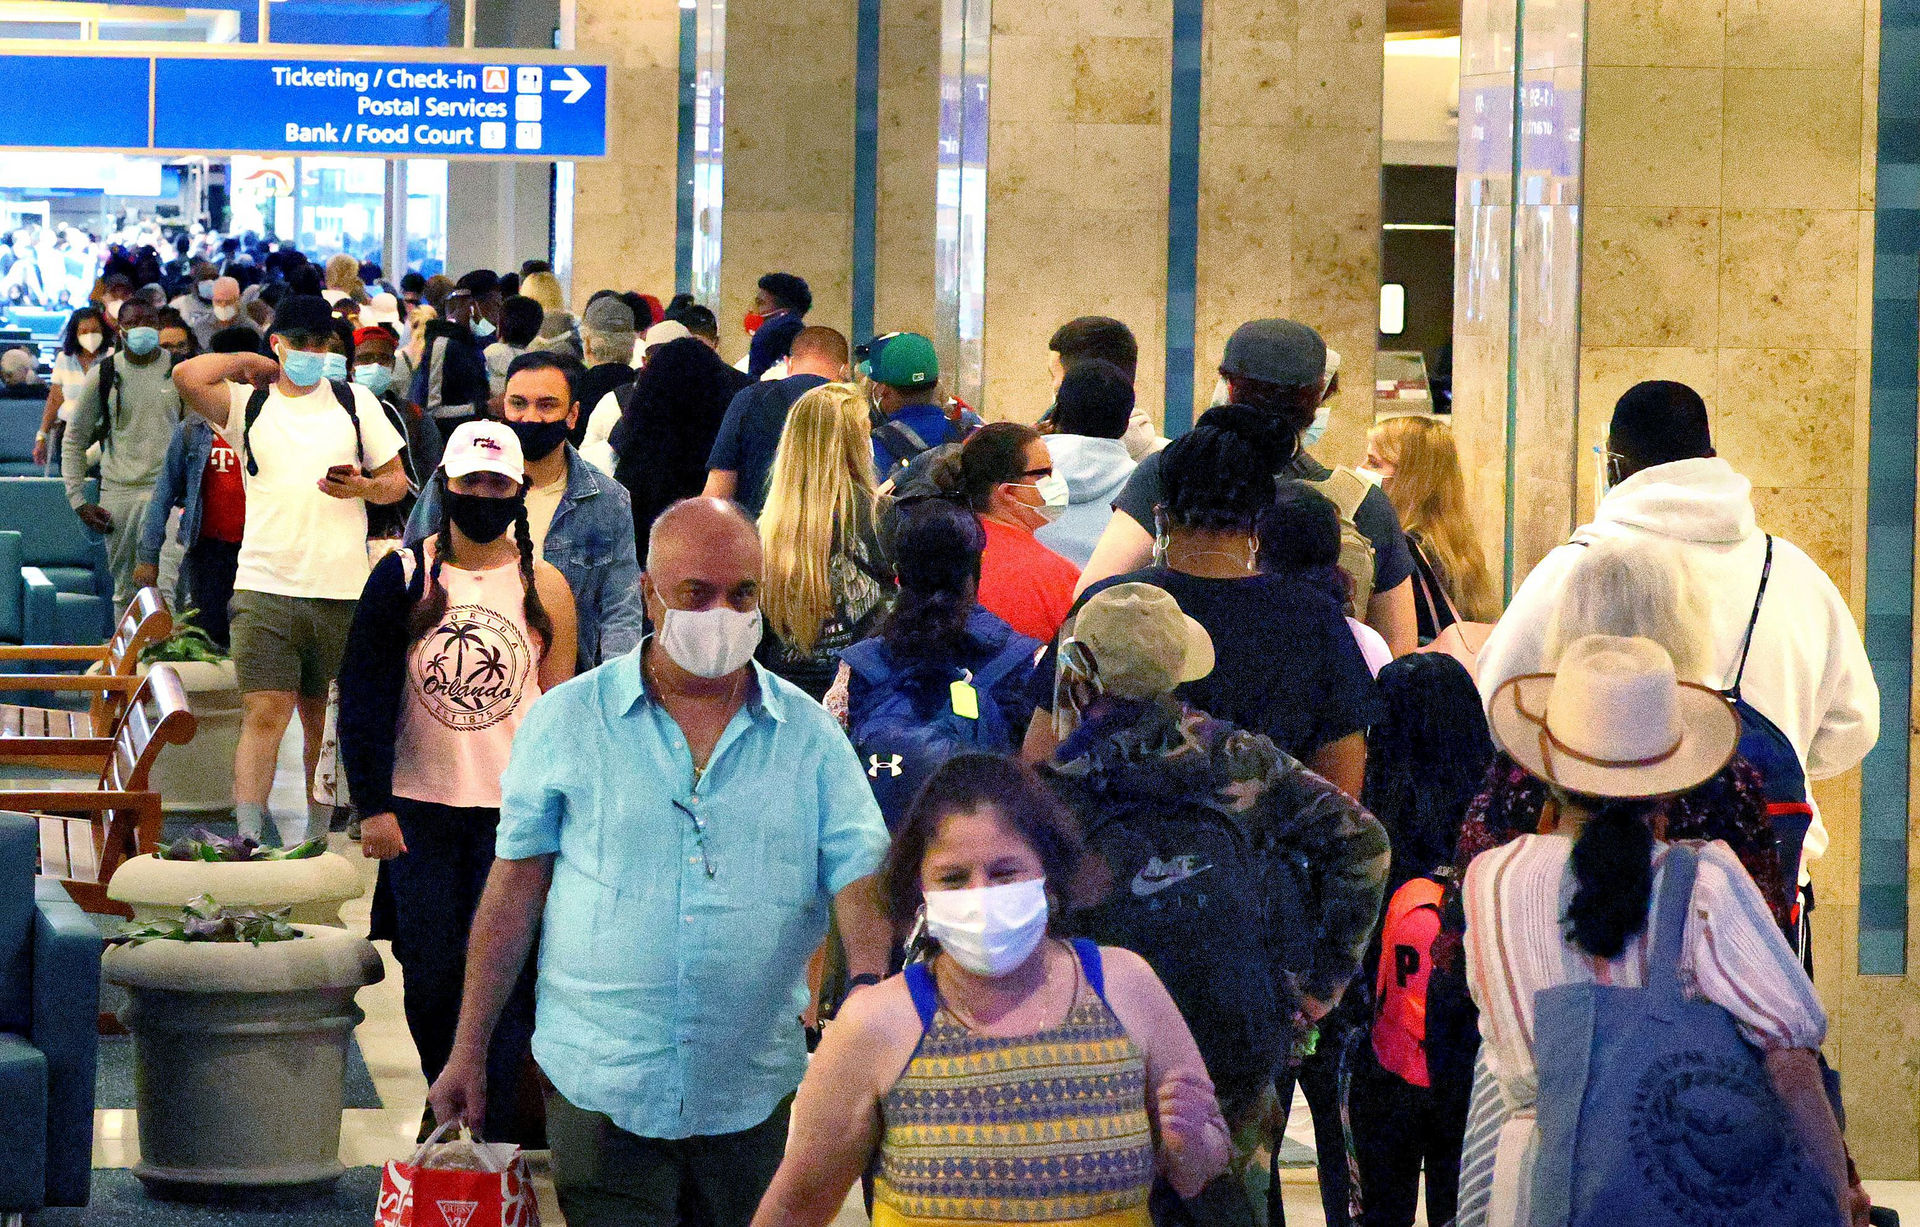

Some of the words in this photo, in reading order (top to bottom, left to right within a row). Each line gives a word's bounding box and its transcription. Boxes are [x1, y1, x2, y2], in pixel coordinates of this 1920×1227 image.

[272, 66, 369, 92] Ticketing
[373, 68, 383, 88] /
[387, 68, 477, 89] Check-in
[358, 96, 420, 116] Postal
[425, 97, 508, 118] Services
[286, 122, 339, 142] Bank
[342, 123, 353, 143] /
[356, 123, 409, 144] Food
[414, 124, 474, 145] Court
[211, 447, 234, 473] T
[423, 675, 514, 700] Orlando
[463, 710, 493, 724] 1875
[1395, 944, 1420, 988] P
